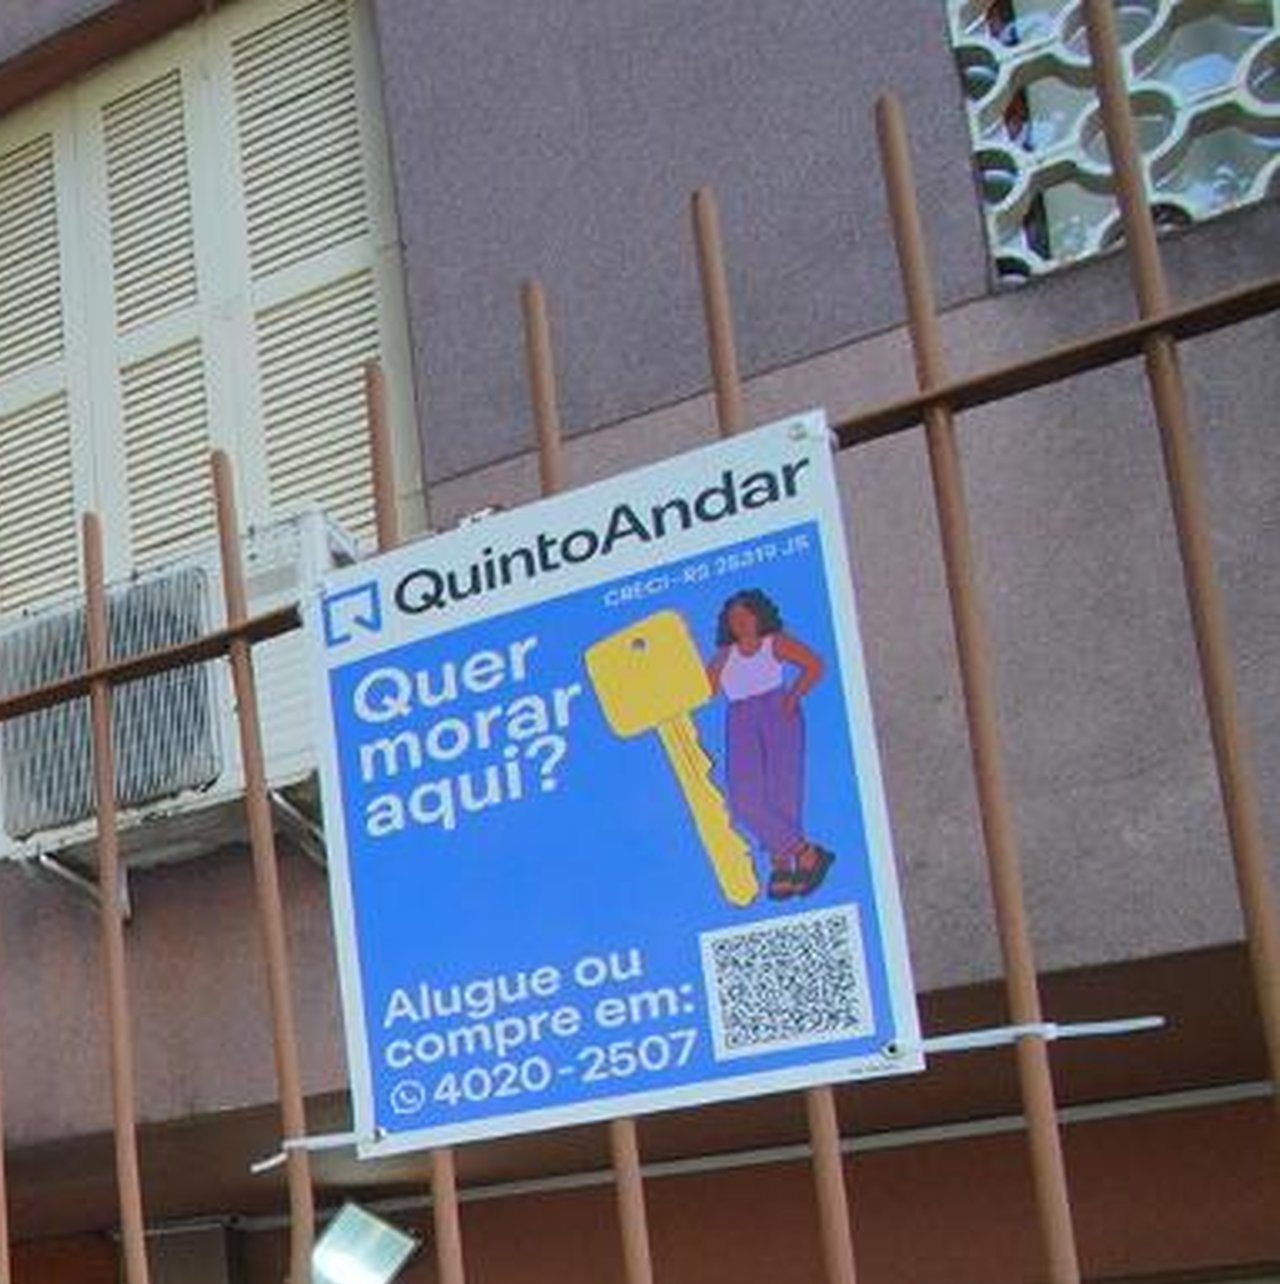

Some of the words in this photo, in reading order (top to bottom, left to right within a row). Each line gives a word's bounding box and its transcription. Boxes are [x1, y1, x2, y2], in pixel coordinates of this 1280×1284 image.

[395, 456, 810, 614] QuintoAndar
[354, 636, 538, 720] Quer
[361, 685, 583, 783] morar
[366, 737, 566, 839] aqui?
[385, 966, 560, 1027] Alugue
[576, 947, 642, 983] ou
[385, 1003, 582, 1069] compre
[596, 983, 694, 1026] em:
[435, 1030, 698, 1107] 4020-2507
